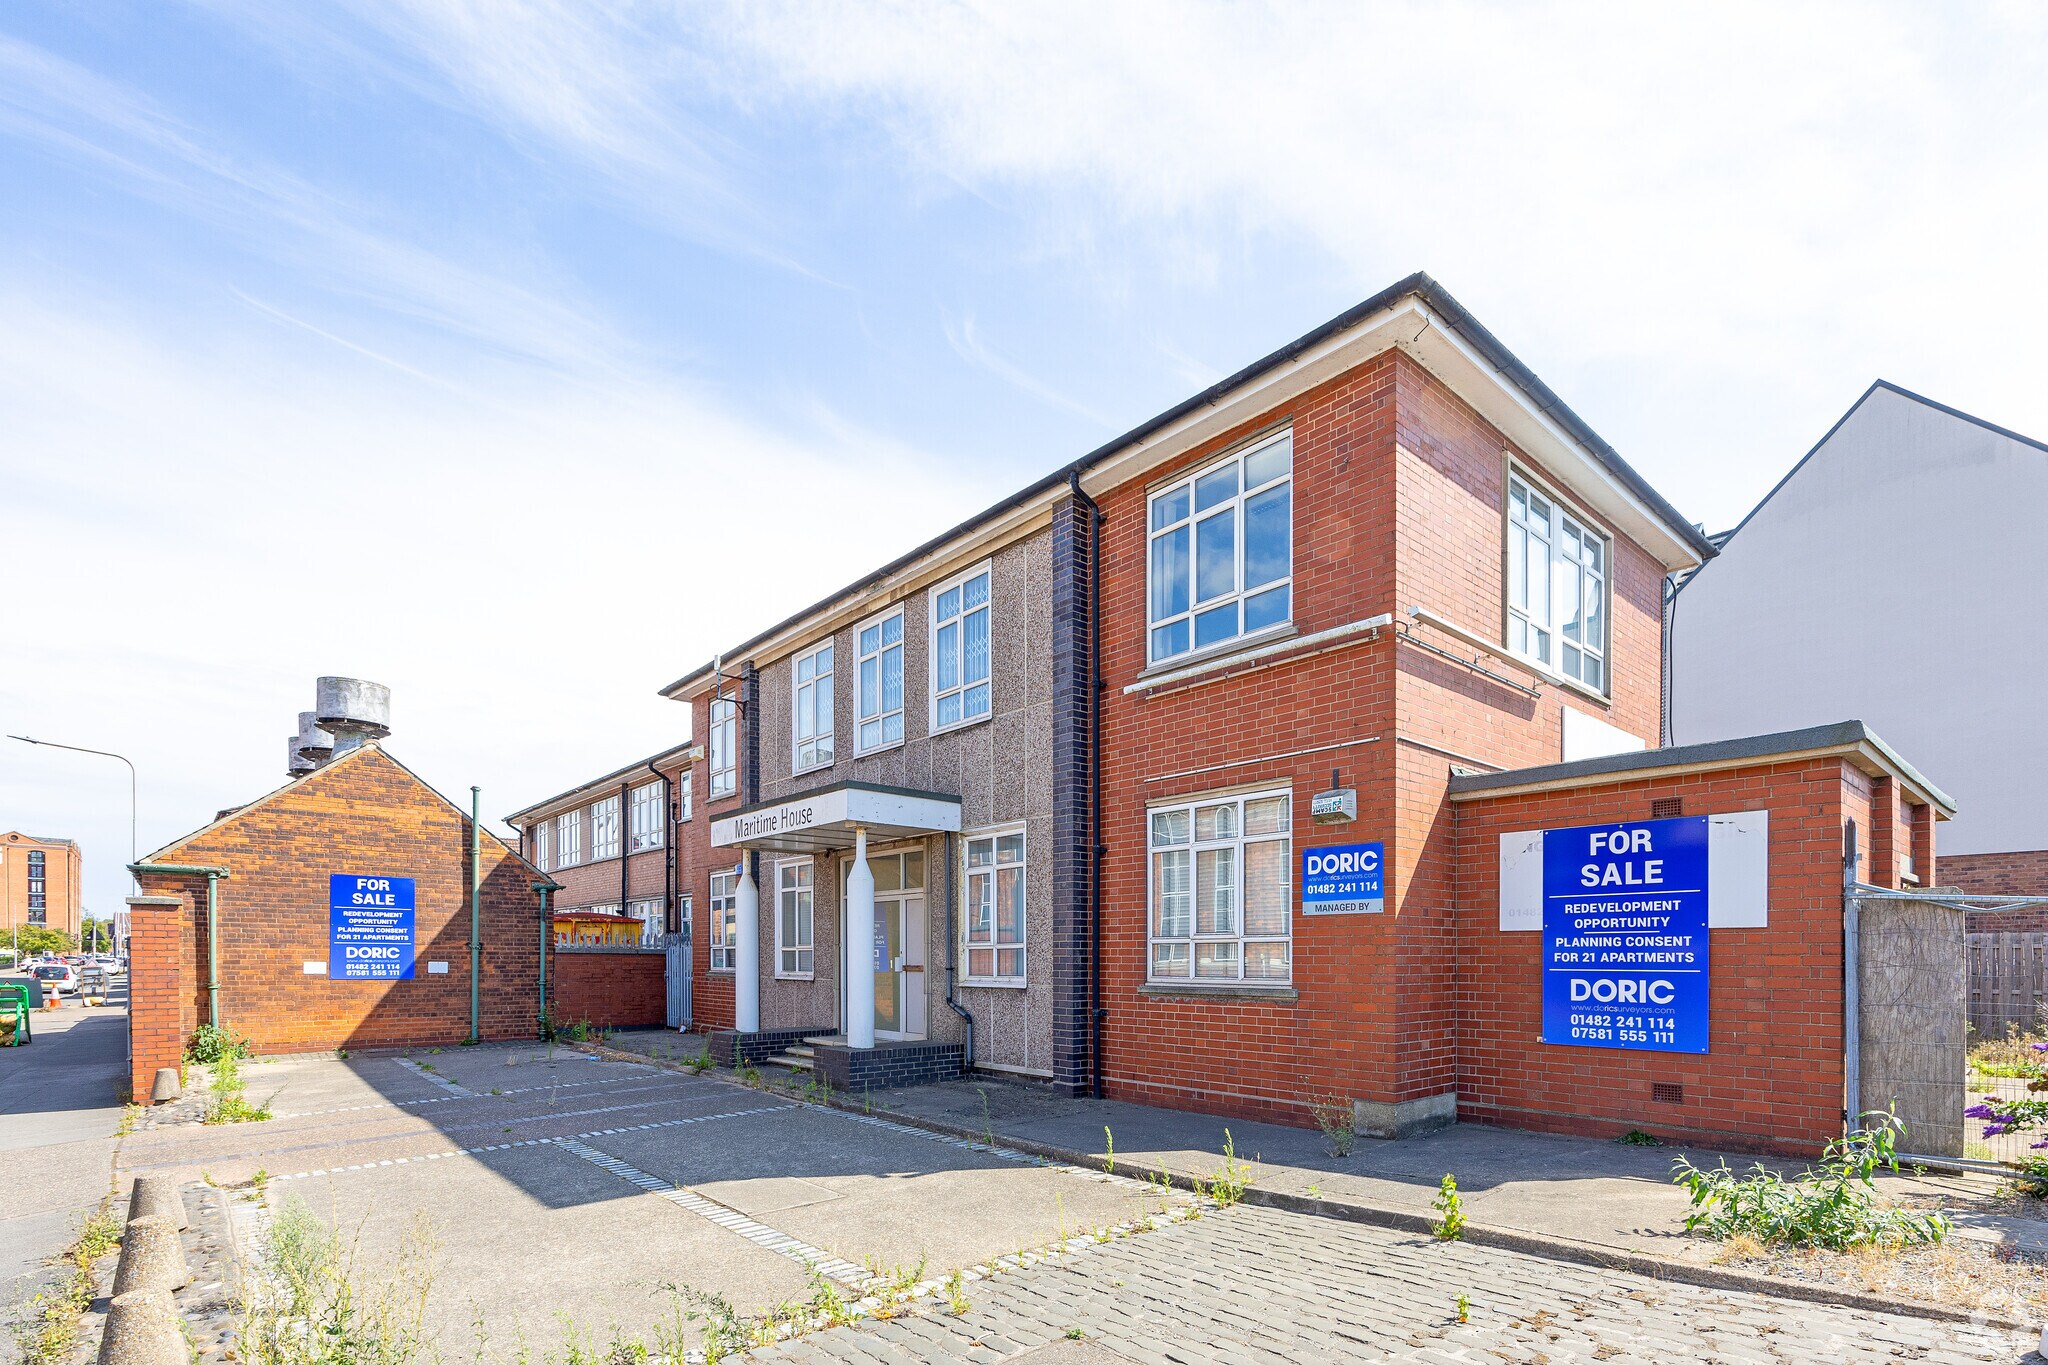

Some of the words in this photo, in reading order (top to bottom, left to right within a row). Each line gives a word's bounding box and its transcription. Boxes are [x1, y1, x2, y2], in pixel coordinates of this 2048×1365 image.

[735, 815, 777, 839] Maritime
[781, 807, 813, 829] House
[1590, 829, 1653, 856] FOR
[1308, 851, 1377, 875] DORIC
[1581, 860, 1663, 886] SALE
[357, 879, 389, 891] FOR
[1308, 884, 1335, 894] 01482
[1339, 883, 1355, 892] 241
[1360, 881, 1377, 891] 114
[352, 893, 395, 905] SALE
[1315, 904, 1356, 912] MANAGED
[1565, 900, 1681, 913] REDEVELOPMENT
[1575, 917, 1670, 928] OPPORTUNITY
[1556, 937, 1621, 947] PLANNING
[1626, 936, 1692, 946] CONSENT
[346, 947, 400, 958] DORIC
[1555, 953, 1578, 962] FOR
[1583, 953, 1594, 962] 21
[1601, 953, 1694, 962] APARTMENTS
[1571, 979, 1674, 1004] DORIC
[1571, 1004, 1675, 1015] www.doricsurveyors.com
[1571, 1014, 1611, 1026] 01482
[1616, 1016, 1641, 1027] 241
[1648, 1018, 1674, 1029] 114
[1572, 1028, 1612, 1039] 07581
[1620, 1030, 1646, 1041] 555
[1653, 1032, 1673, 1043] 111
